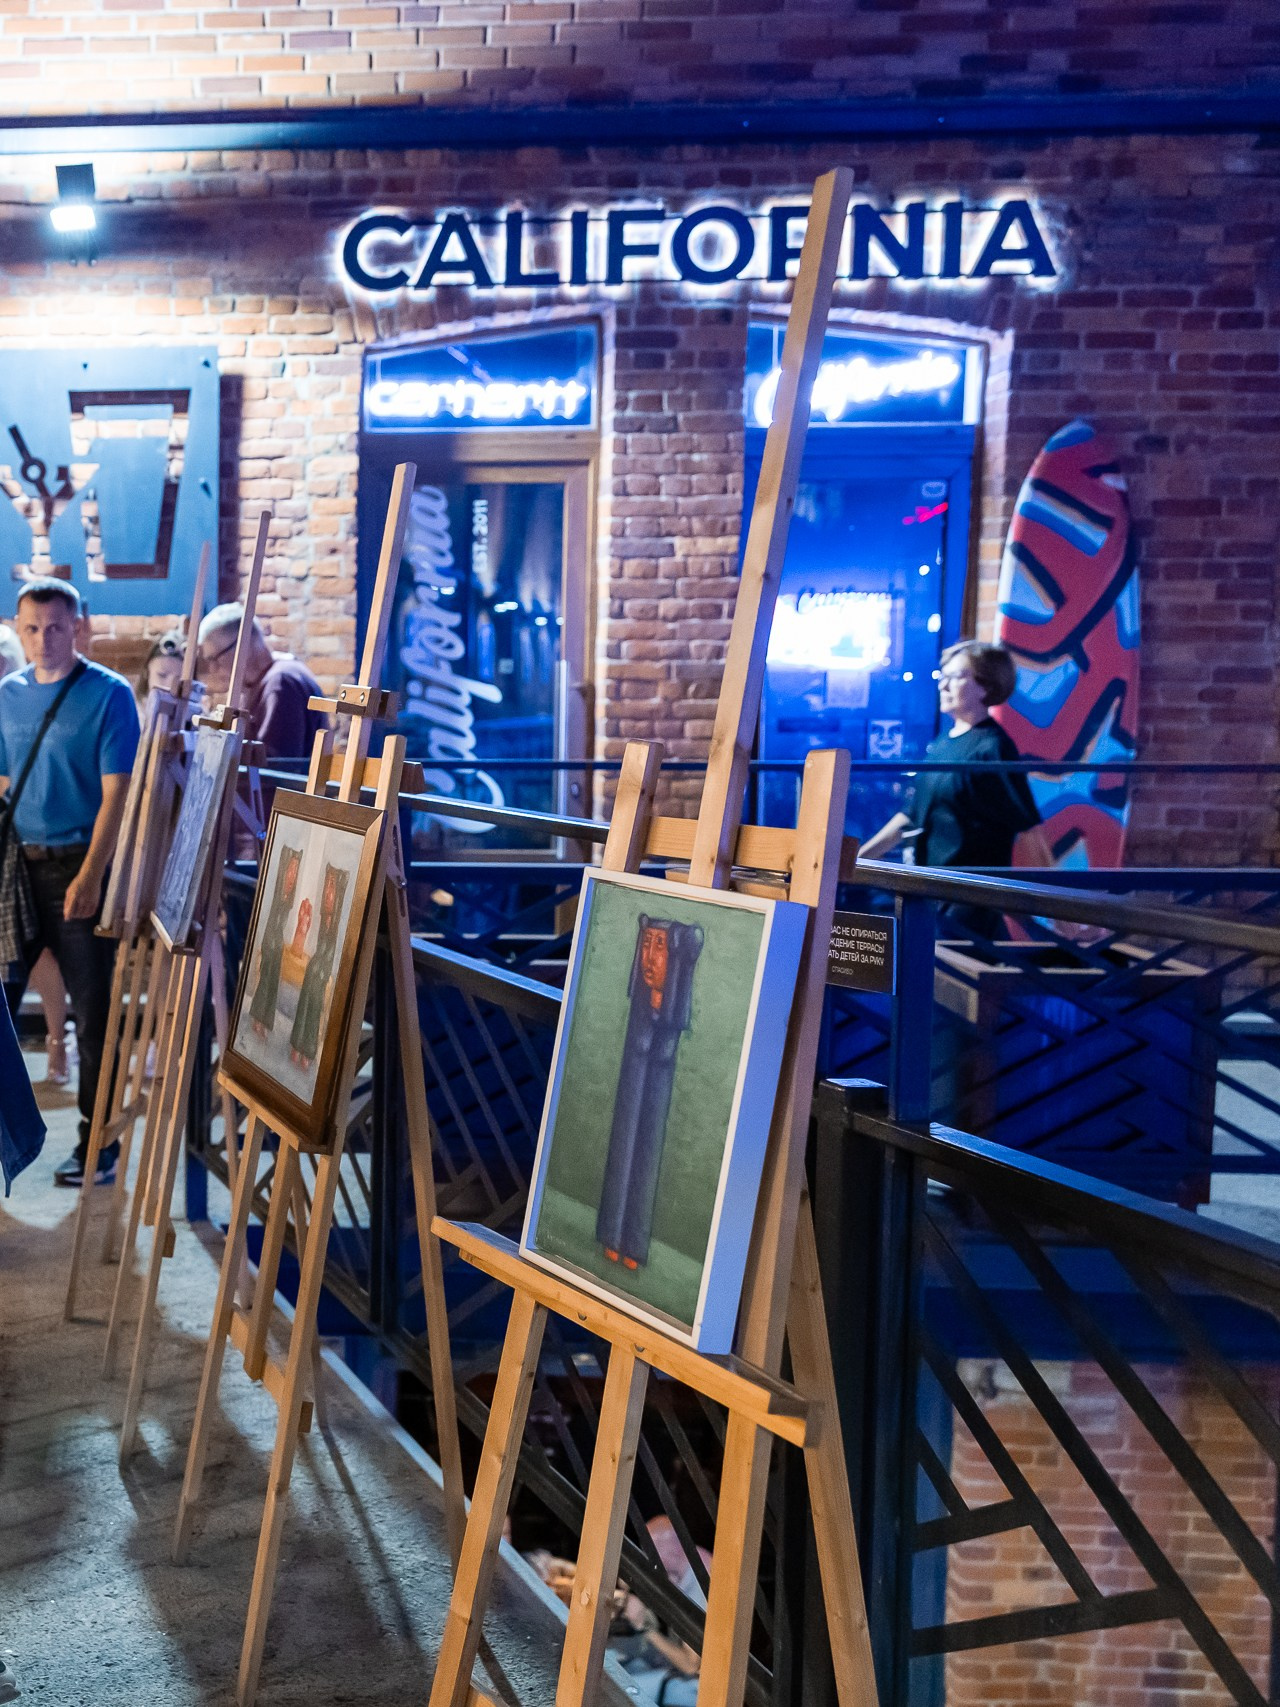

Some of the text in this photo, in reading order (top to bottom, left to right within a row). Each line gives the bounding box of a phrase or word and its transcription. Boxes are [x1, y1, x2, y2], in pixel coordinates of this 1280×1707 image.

[472, 499, 488, 537] 2011
[831, 926, 887, 940] АС НЕ ОПИРАТЬСЯ
[856, 941, 884, 953] ТЕРРАСЫ
[840, 951, 860, 962] ДЕТЕЙ
[861, 954, 869, 963] ЗА
